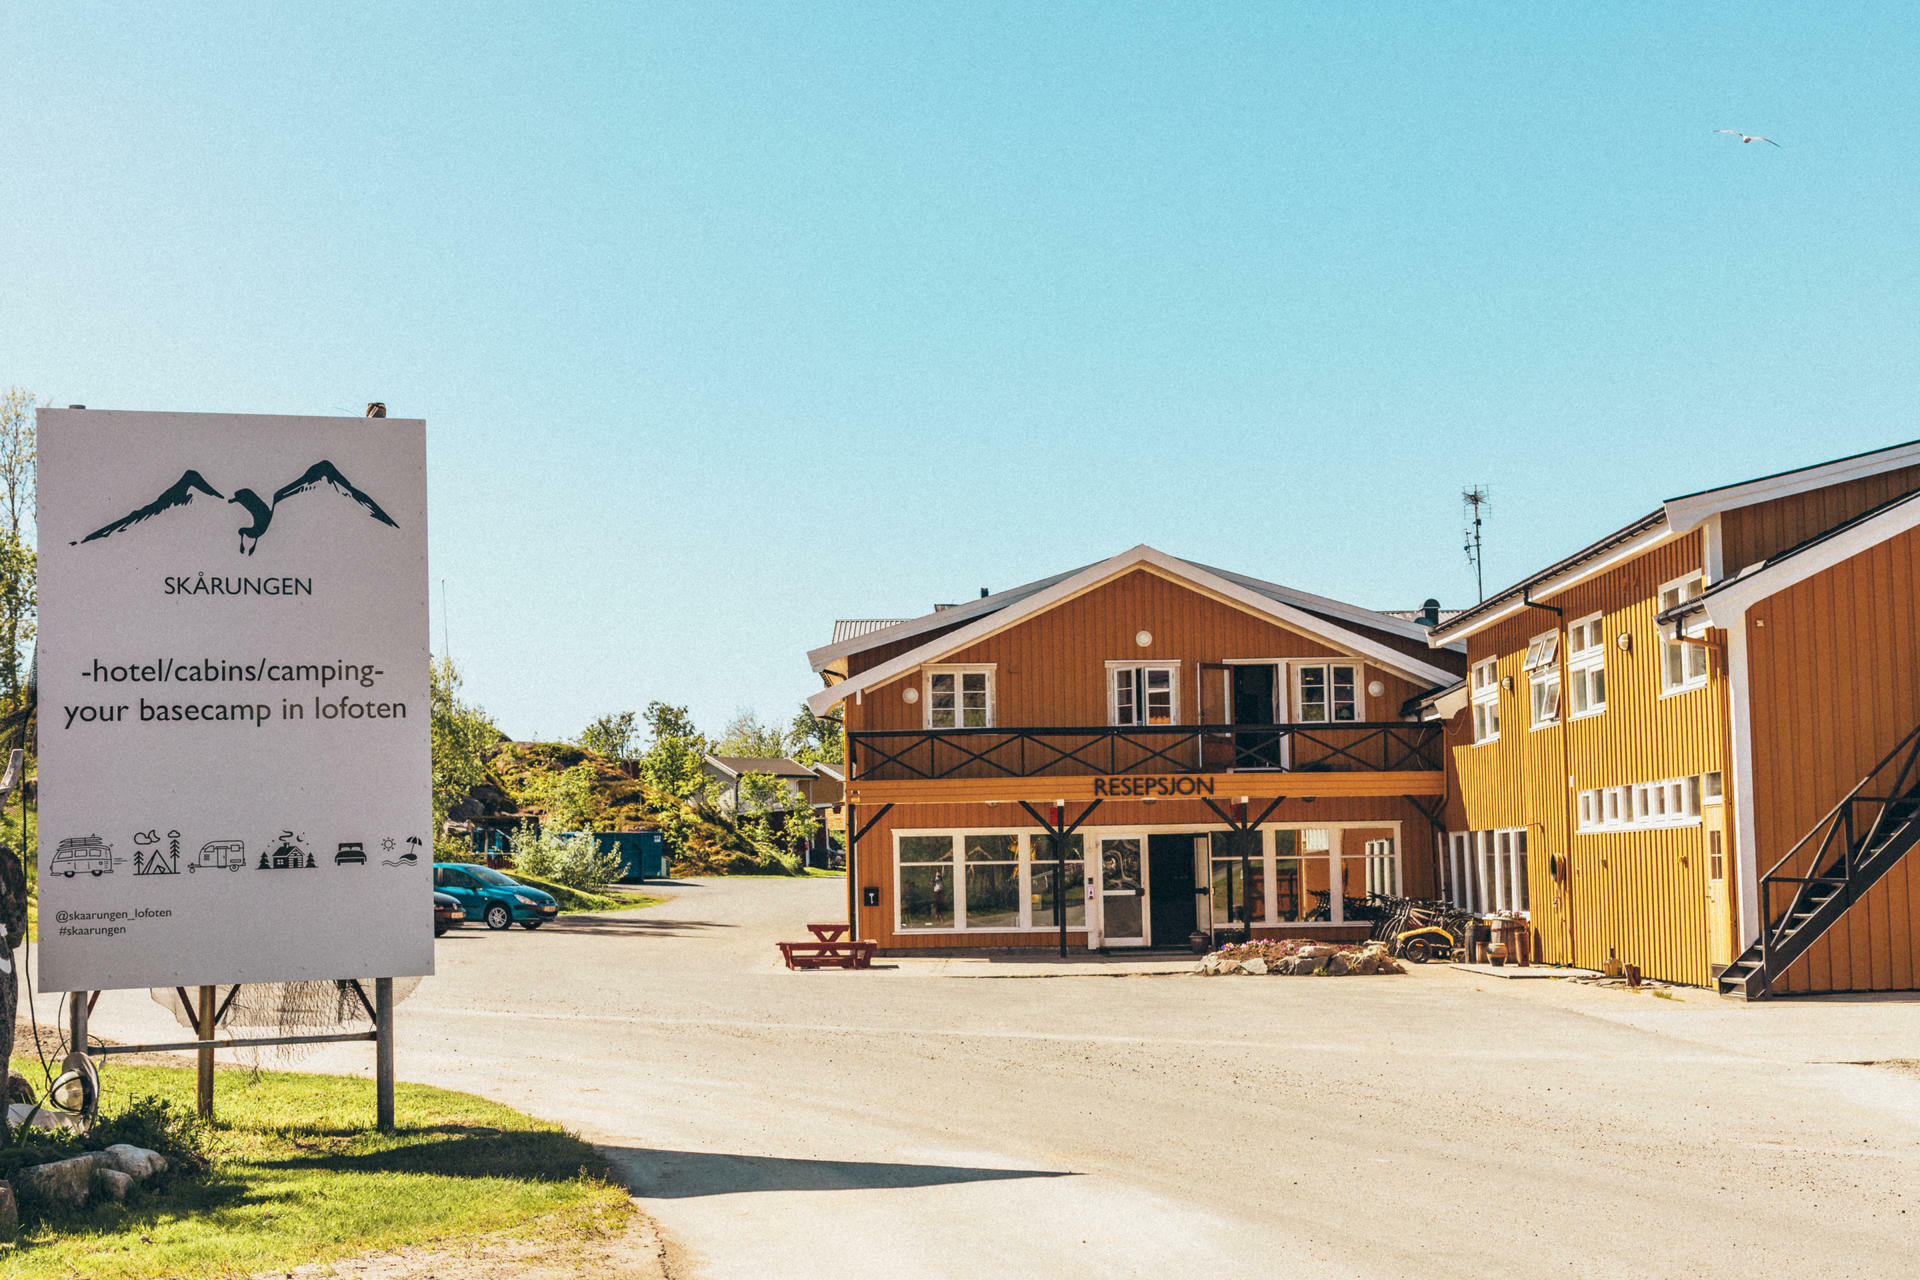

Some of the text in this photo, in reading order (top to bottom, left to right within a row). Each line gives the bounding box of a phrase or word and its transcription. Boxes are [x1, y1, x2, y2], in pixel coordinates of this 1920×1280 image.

[164, 571, 312, 596] SKÅRUNGEN
[81, 657, 384, 688] -hotel/cabins/camping-
[64, 695, 407, 730] your basecamp in lofoten
[1094, 776, 1214, 797] RESEPSJON
[56, 908, 172, 923] @skaarungen_lofoten
[59, 925, 126, 937] #skaarungen
